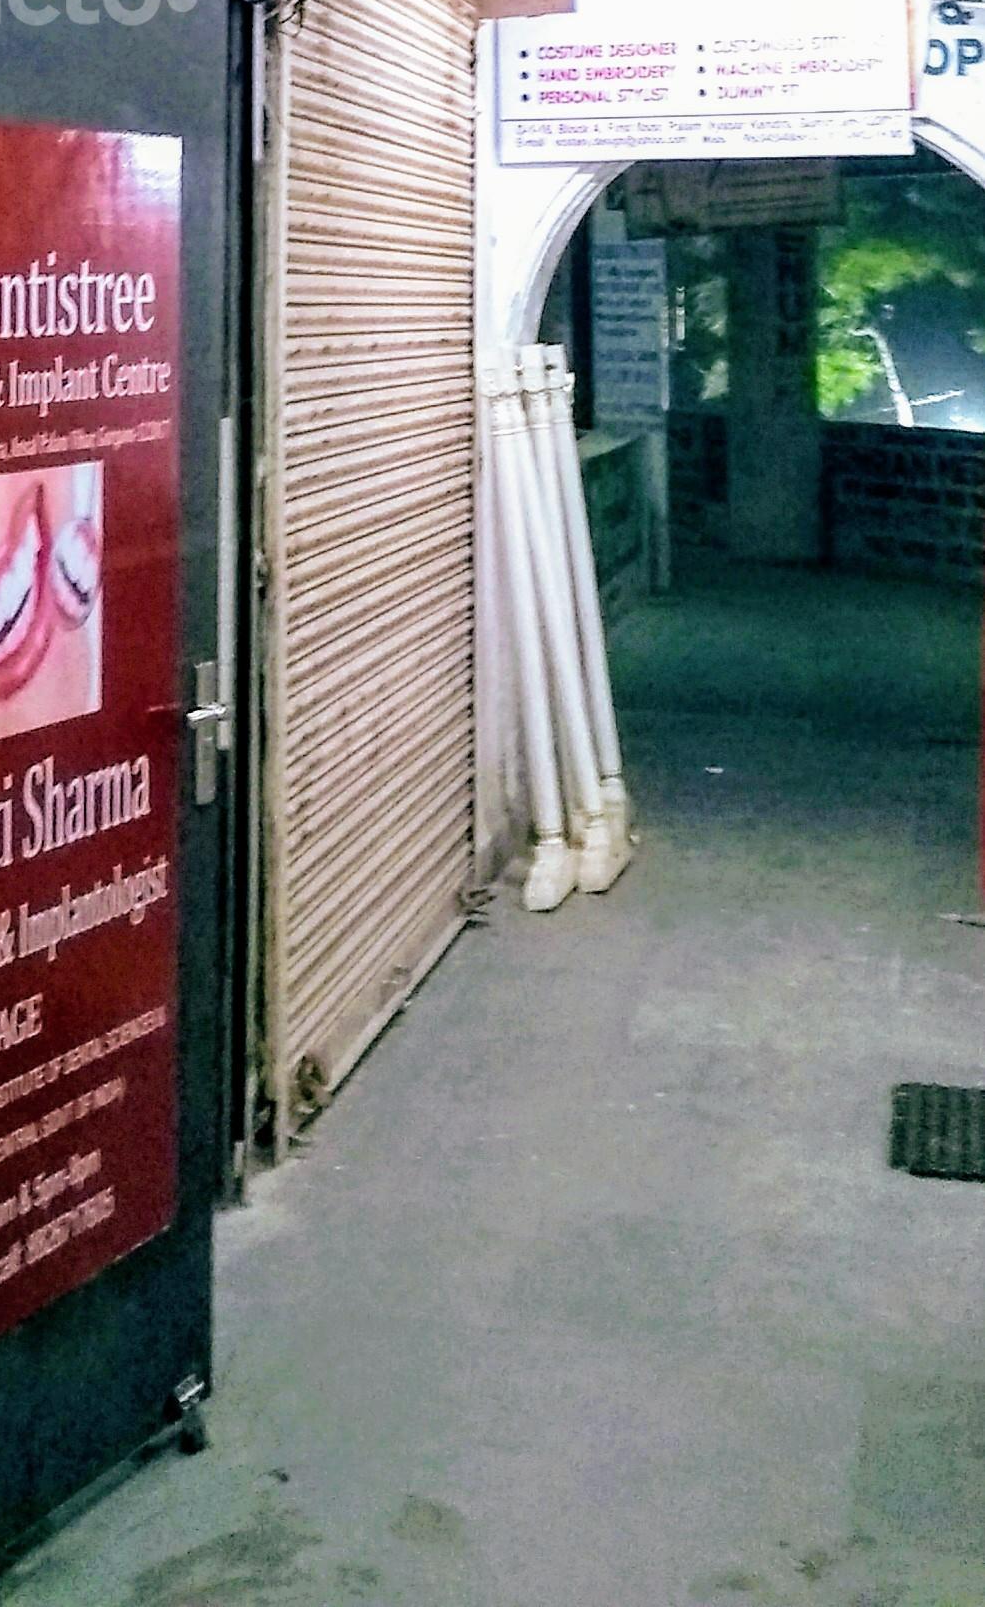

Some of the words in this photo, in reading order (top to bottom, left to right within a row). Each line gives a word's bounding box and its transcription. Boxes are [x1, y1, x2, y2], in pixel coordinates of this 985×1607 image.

[8, 354, 100, 417] Implant
[101, 352, 172, 400] Centre
[21, 754, 151, 859] Sharma
[17, 854, 170, 962] Implantologist
